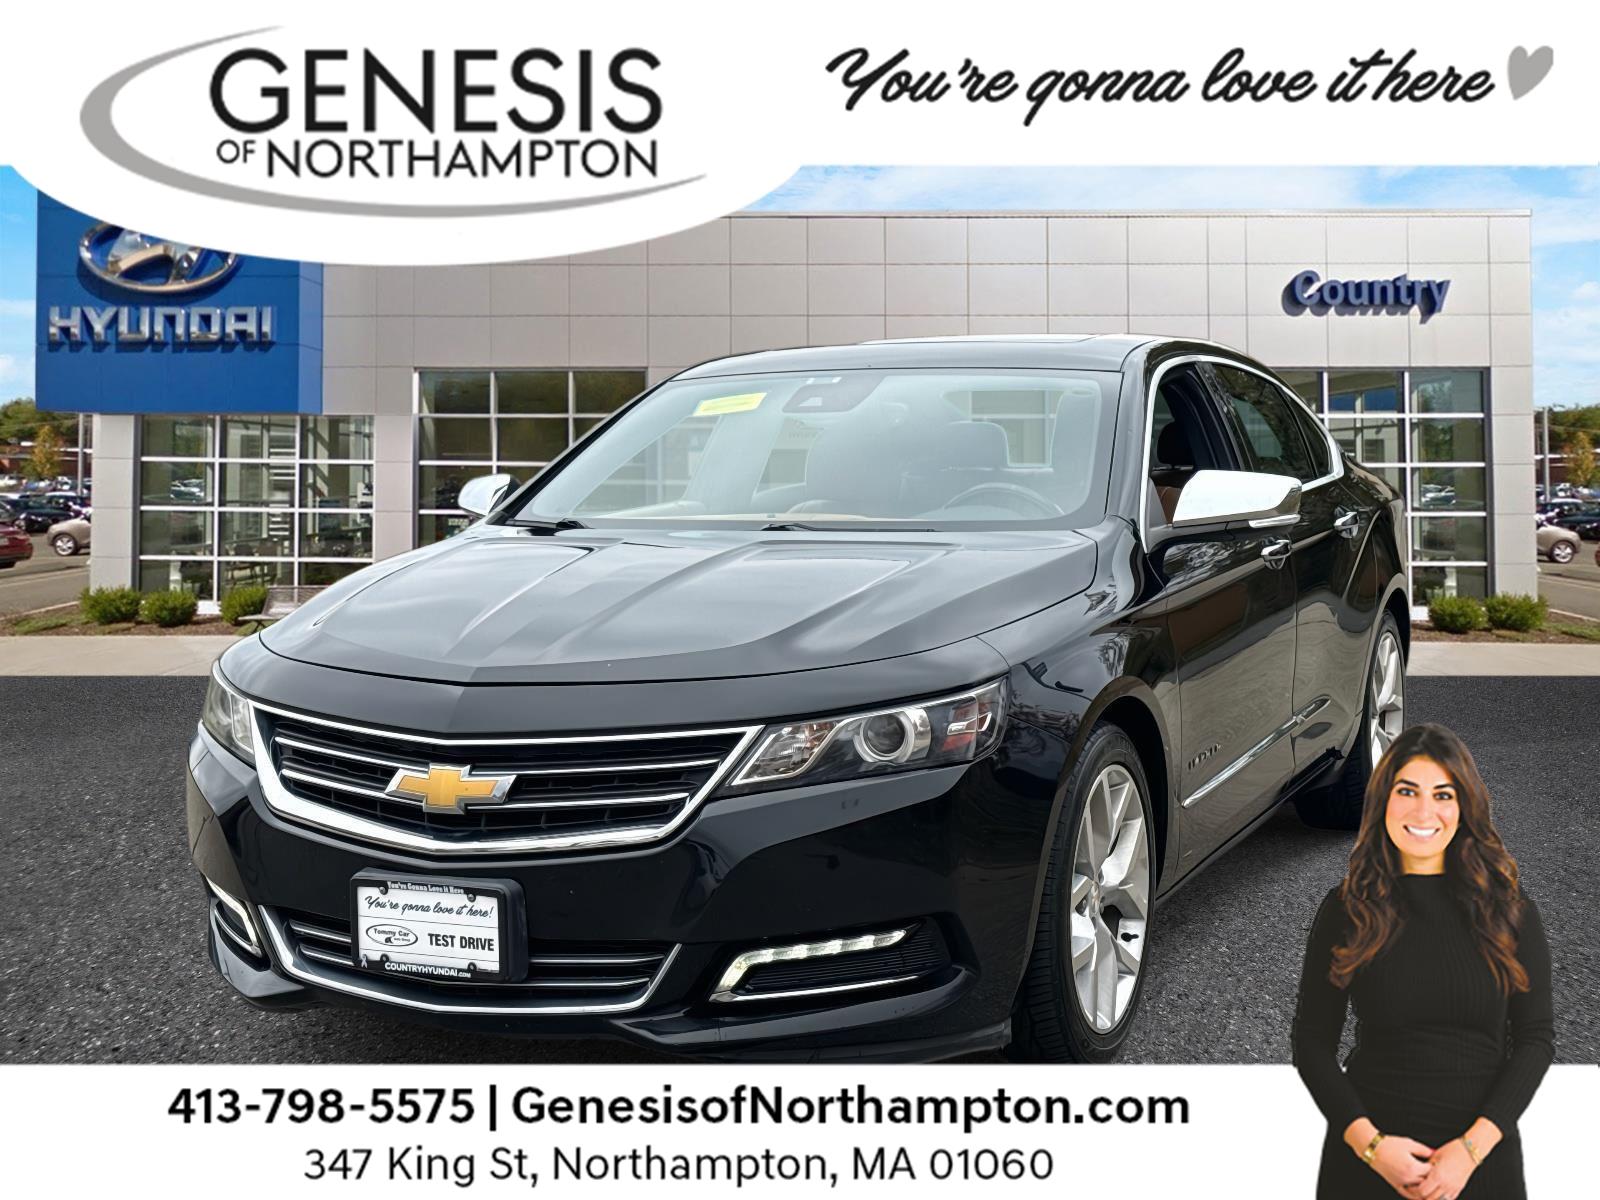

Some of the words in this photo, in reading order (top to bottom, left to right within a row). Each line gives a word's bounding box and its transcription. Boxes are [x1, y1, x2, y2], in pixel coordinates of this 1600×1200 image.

[1286, 269, 1451, 321] Country
[49, 305, 273, 343] HYUNDAI
[364, 896, 399, 910] You're
[401, 903, 432, 915] gonna
[433, 902, 454, 914] love
[456, 904, 468, 915] it
[466, 905, 495, 919] here!
[374, 928, 397, 937] Tommy
[428, 933, 456, 948] TEST
[460, 936, 495, 951] DRIVE
[385, 962, 472, 978] COUNTRYHYUNDAI.COM
